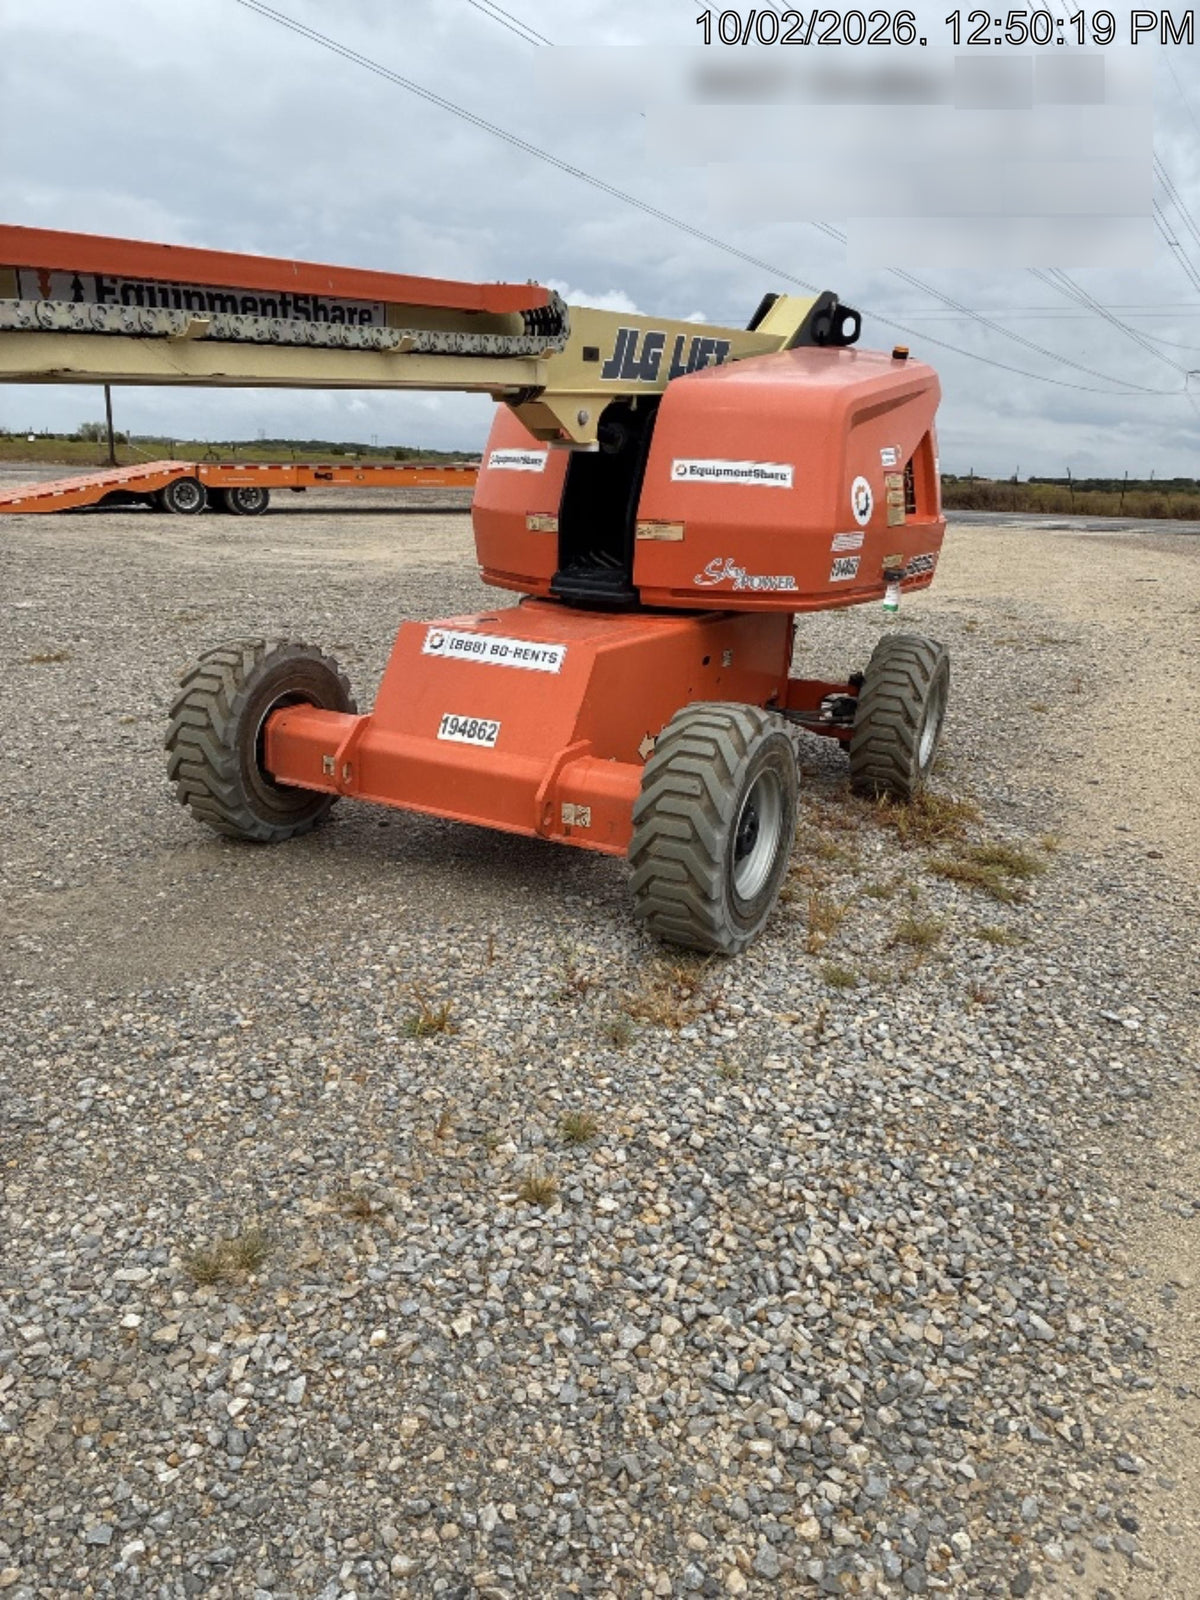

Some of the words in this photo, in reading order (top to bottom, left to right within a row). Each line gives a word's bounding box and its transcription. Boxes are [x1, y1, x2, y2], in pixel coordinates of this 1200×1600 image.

[600, 327, 667, 382] JLG
[689, 465, 788, 481] EquipmentShare
[441, 715, 498, 742] 194862
